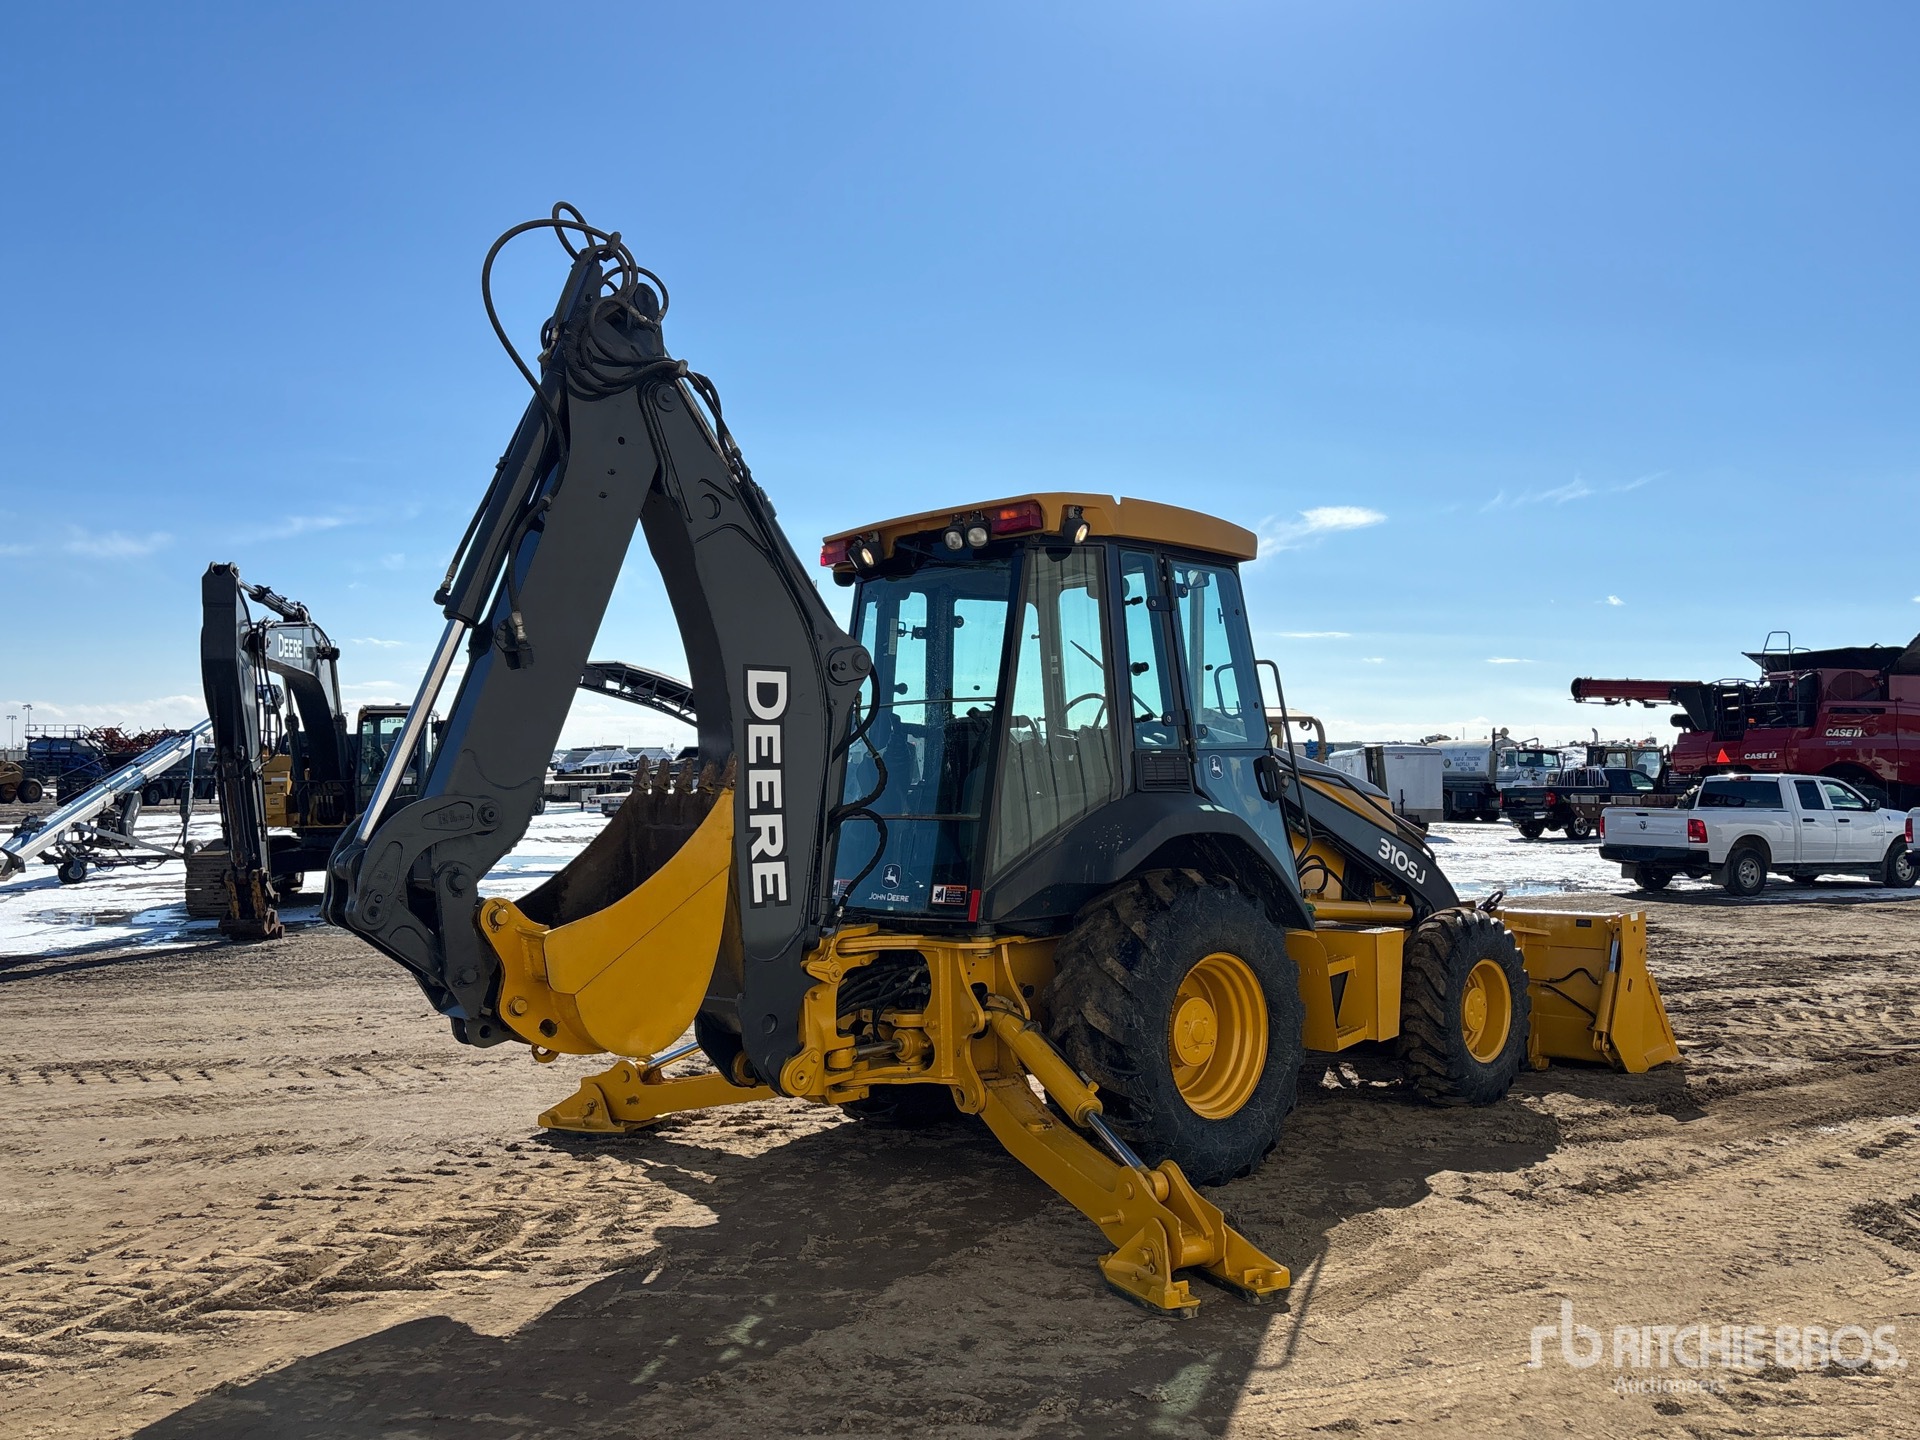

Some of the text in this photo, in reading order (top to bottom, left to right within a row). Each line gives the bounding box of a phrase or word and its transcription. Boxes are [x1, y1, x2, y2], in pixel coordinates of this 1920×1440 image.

[278, 633, 302, 658] DEERE
[1826, 728, 1853, 737] CASE
[1744, 752, 1768, 760] CASE
[747, 669, 788, 904] DEERE
[1378, 838, 1426, 885] 310SJ
[868, 891, 910, 903] JOHN DEERE
